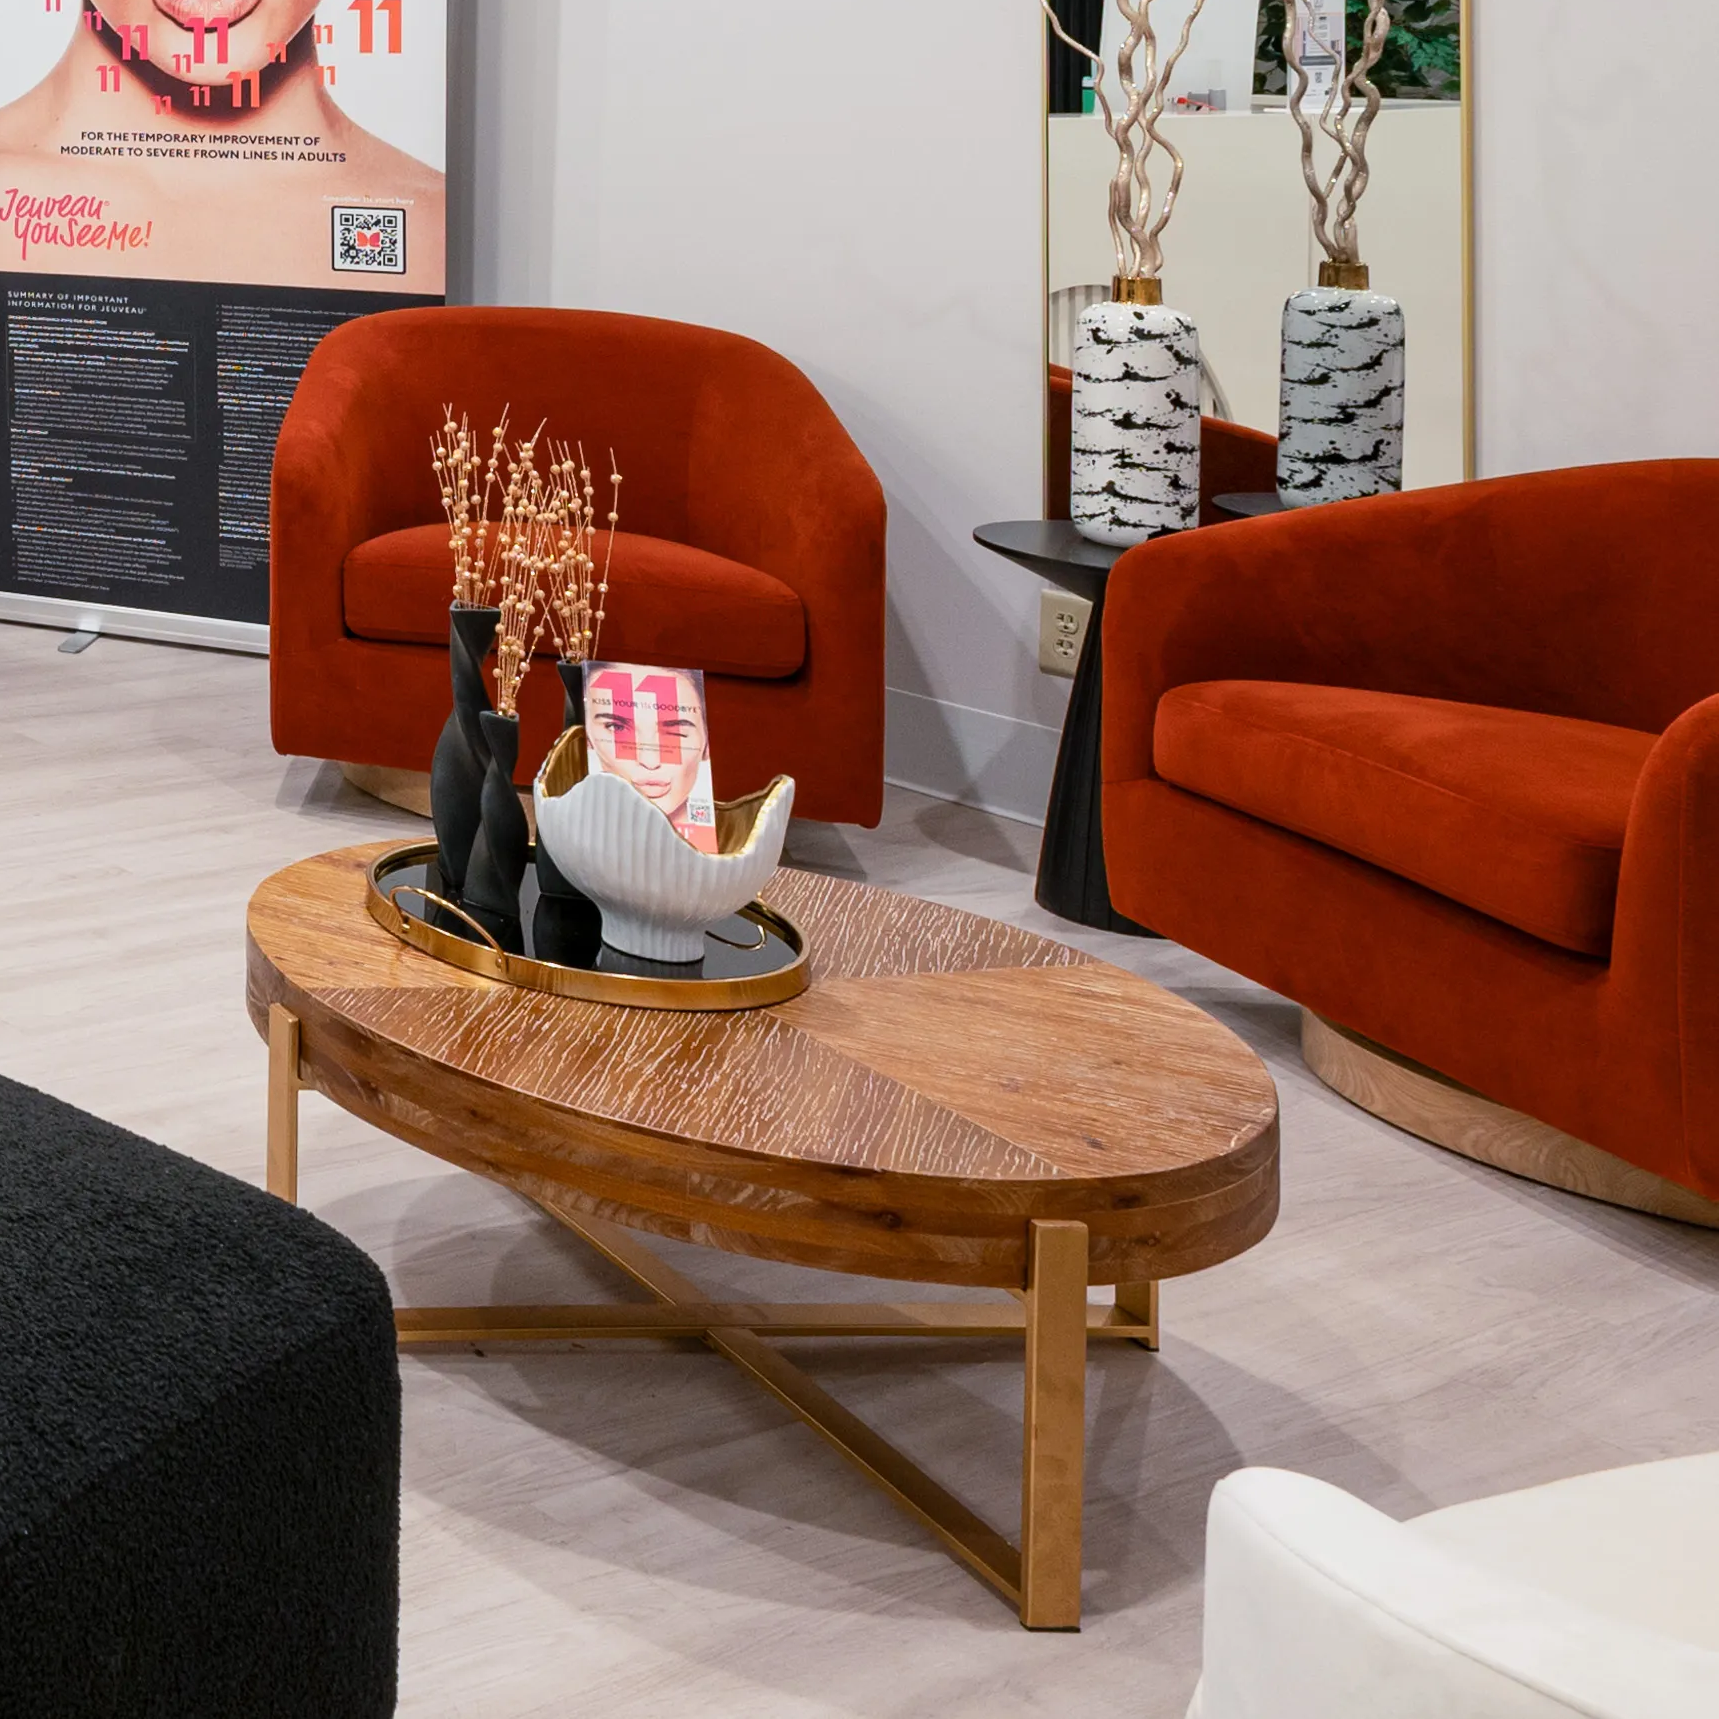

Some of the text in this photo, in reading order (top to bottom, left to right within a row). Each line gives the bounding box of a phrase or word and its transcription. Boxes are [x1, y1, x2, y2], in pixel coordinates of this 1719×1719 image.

[83, 10, 103, 31] 11
[117, 24, 149, 60] 11
[183, 17, 229, 64] 11
[313, 24, 333, 44] 11
[266, 41, 286, 63] 11
[171, 54, 192, 73] 11
[95, 65, 121, 92] 11
[313, 65, 336, 85] 11
[189, 86, 211, 106] 11
[225, 70, 260, 108] 11
[150, 95, 172, 115] 11
[81, 131, 321, 146] FOR THE TEMPORARY IMPROVEMENT OF
[60, 145, 347, 162] MODERATE TO SEVERE FROWN LINES IN ADULTS
[7, 290, 129, 304] SUMMARY OF IMPORTANT
[7, 300, 75, 310] INFORMATION
[78, 303, 97, 312] FOR
[592, 698, 612, 706] KISS
[613, 699, 639, 709] YOUR
[590, 672, 682, 765] 11
